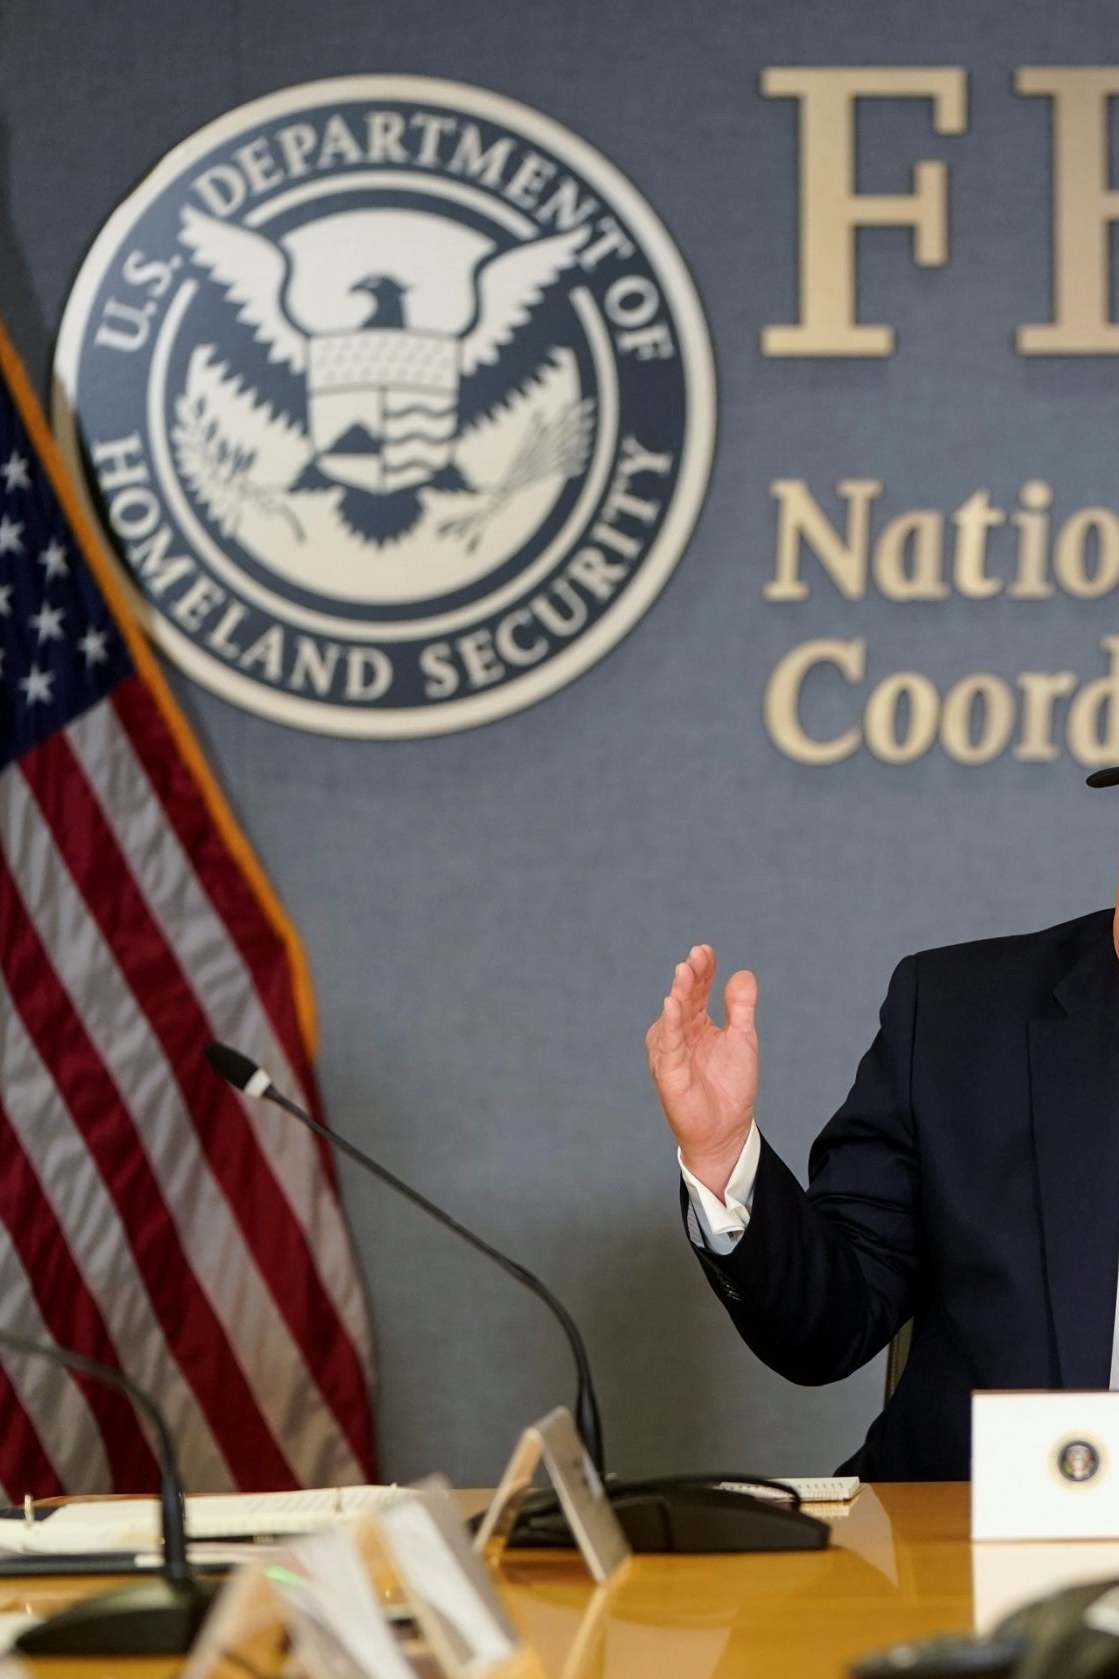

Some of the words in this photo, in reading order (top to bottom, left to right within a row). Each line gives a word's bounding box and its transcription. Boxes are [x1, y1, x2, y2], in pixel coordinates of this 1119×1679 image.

[95, 249, 182, 353] U.S.
[193, 111, 634, 275] DEPARTMENT
[604, 277, 676, 362] OF
[92, 431, 395, 700] HOMELAND
[420, 434, 674, 700] SECURITY
